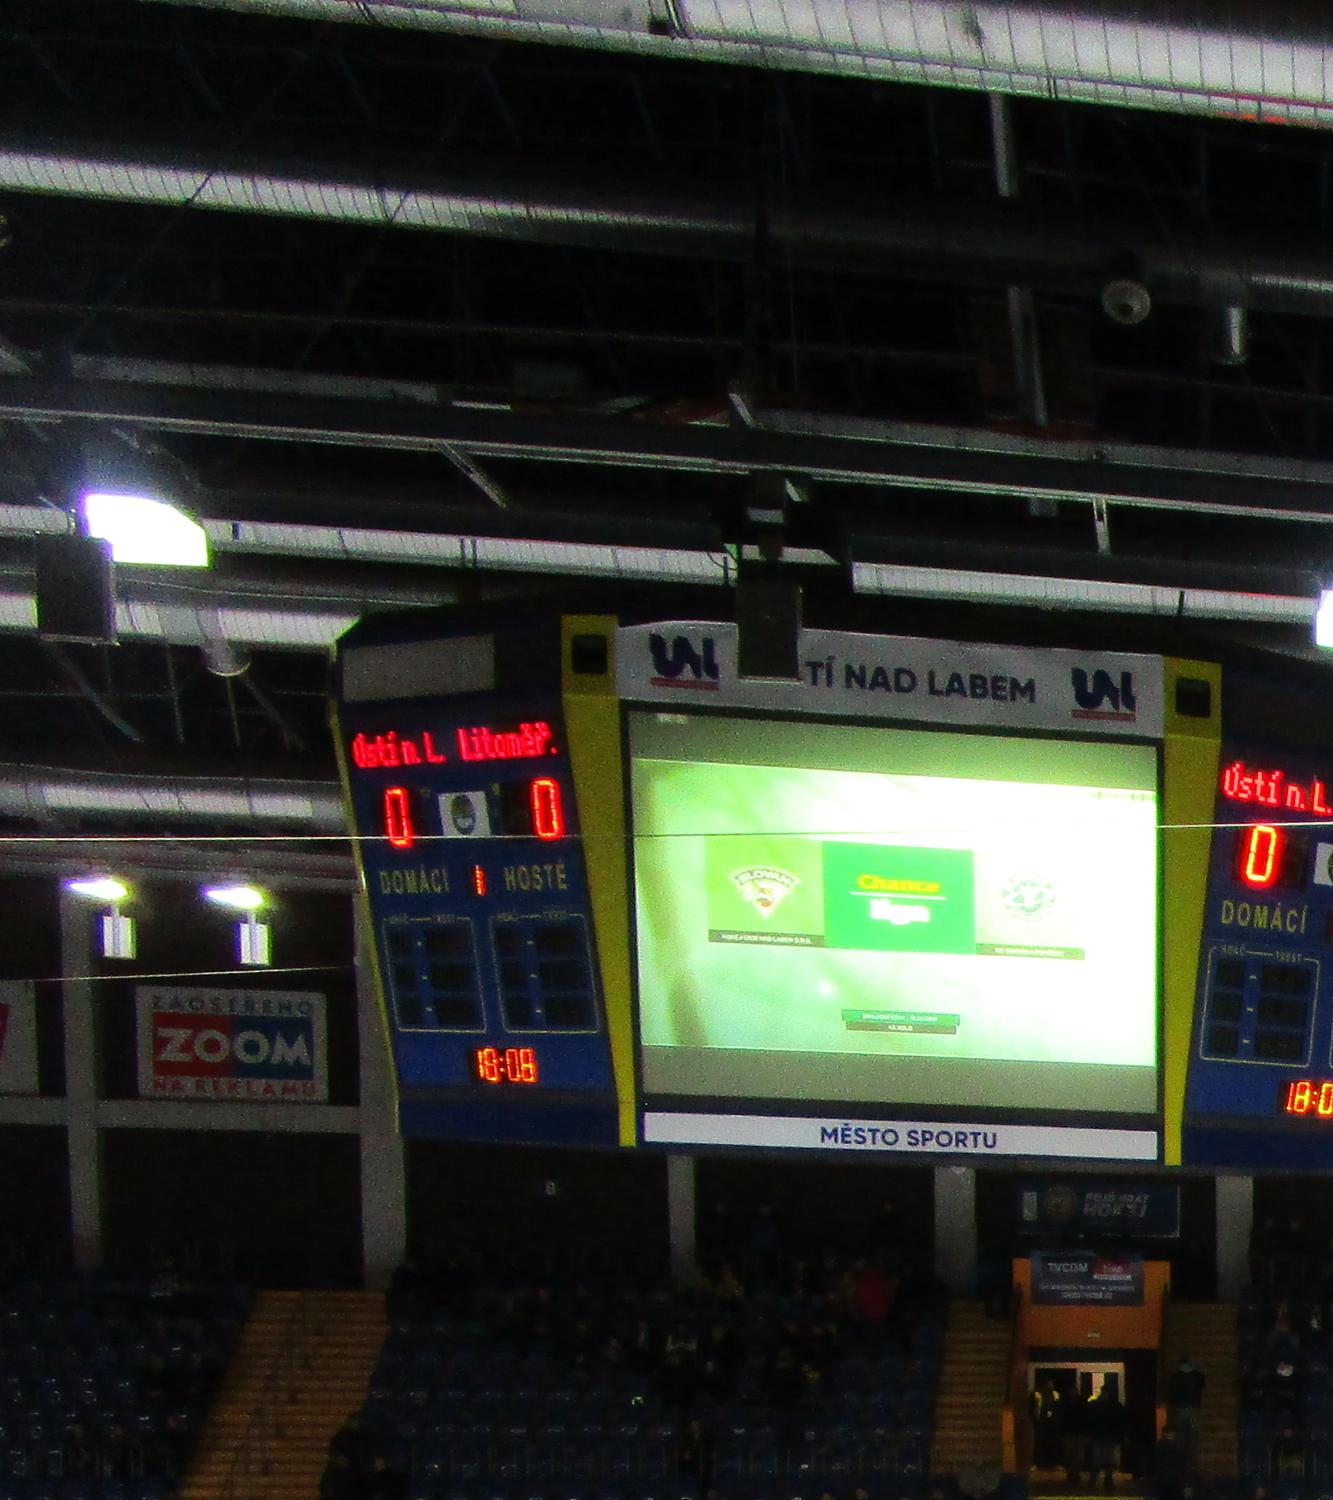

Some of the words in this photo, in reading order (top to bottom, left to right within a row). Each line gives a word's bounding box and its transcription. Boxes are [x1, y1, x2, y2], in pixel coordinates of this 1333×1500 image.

[846, 664, 915, 694] NAD
[928, 668, 1037, 704] LABEM
[384, 786, 415, 848] 0
[531, 779, 564, 841] 0
[1244, 824, 1279, 885] 0
[379, 863, 450, 896] DOMÁCÍ
[504, 859, 569, 892] HOSTÉ
[858, 873, 940, 894] Chance
[1221, 899, 1309, 934] DOMÁCÍ
[156, 1027, 312, 1065] ZOOM
[154, 1079, 186, 1092] NA
[906, 1127, 998, 1152] SPORTU
